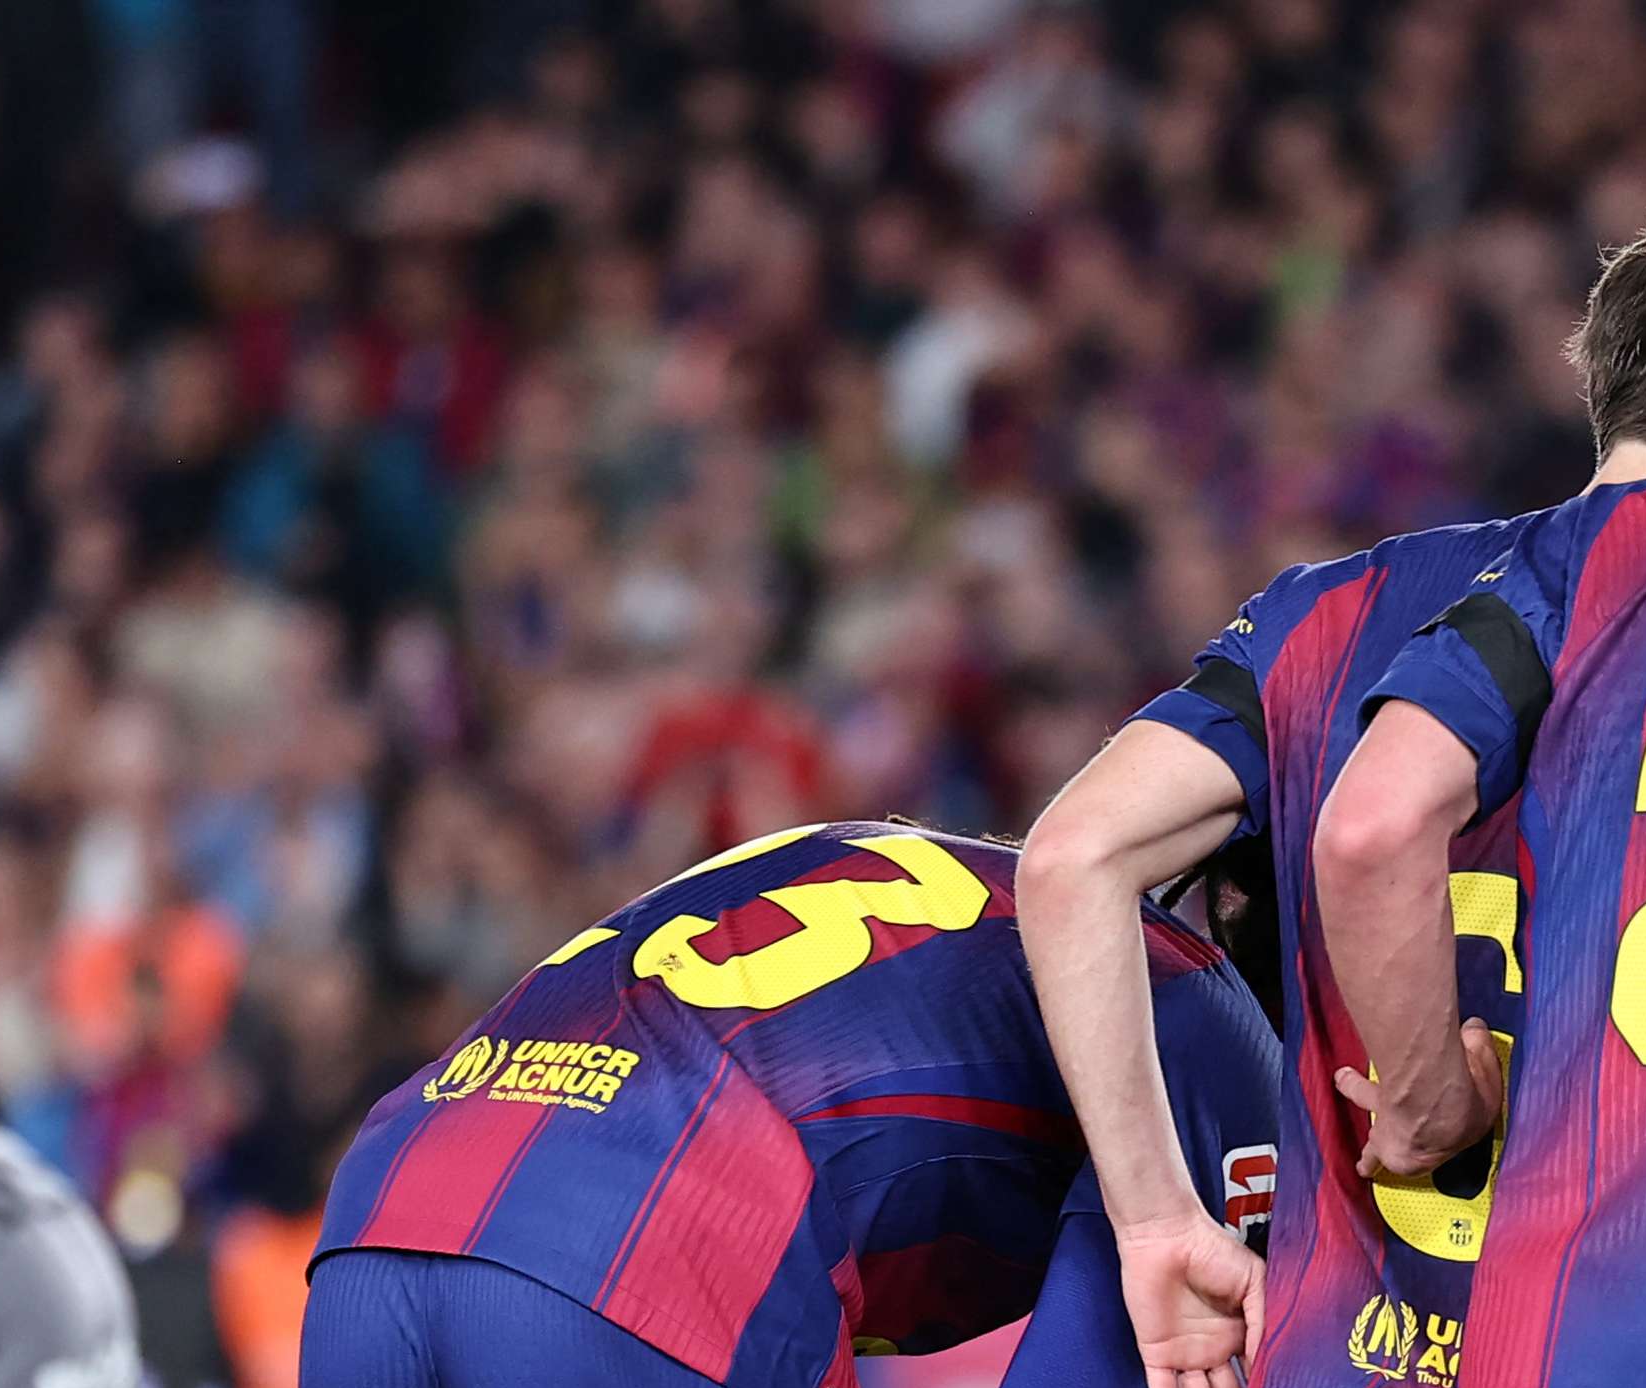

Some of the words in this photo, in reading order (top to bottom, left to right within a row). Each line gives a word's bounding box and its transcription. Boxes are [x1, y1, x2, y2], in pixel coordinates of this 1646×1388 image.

[533, 822, 992, 1010] 3
[510, 1039, 641, 1078] UNHCR
[487, 1089, 506, 1101] The
[505, 1091, 523, 1102] UN
[522, 1091, 564, 1106] Refugee
[562, 1095, 607, 1115] Agency
[491, 1062, 623, 1104] ACNUR
[1415, 1369, 1441, 1386] The
